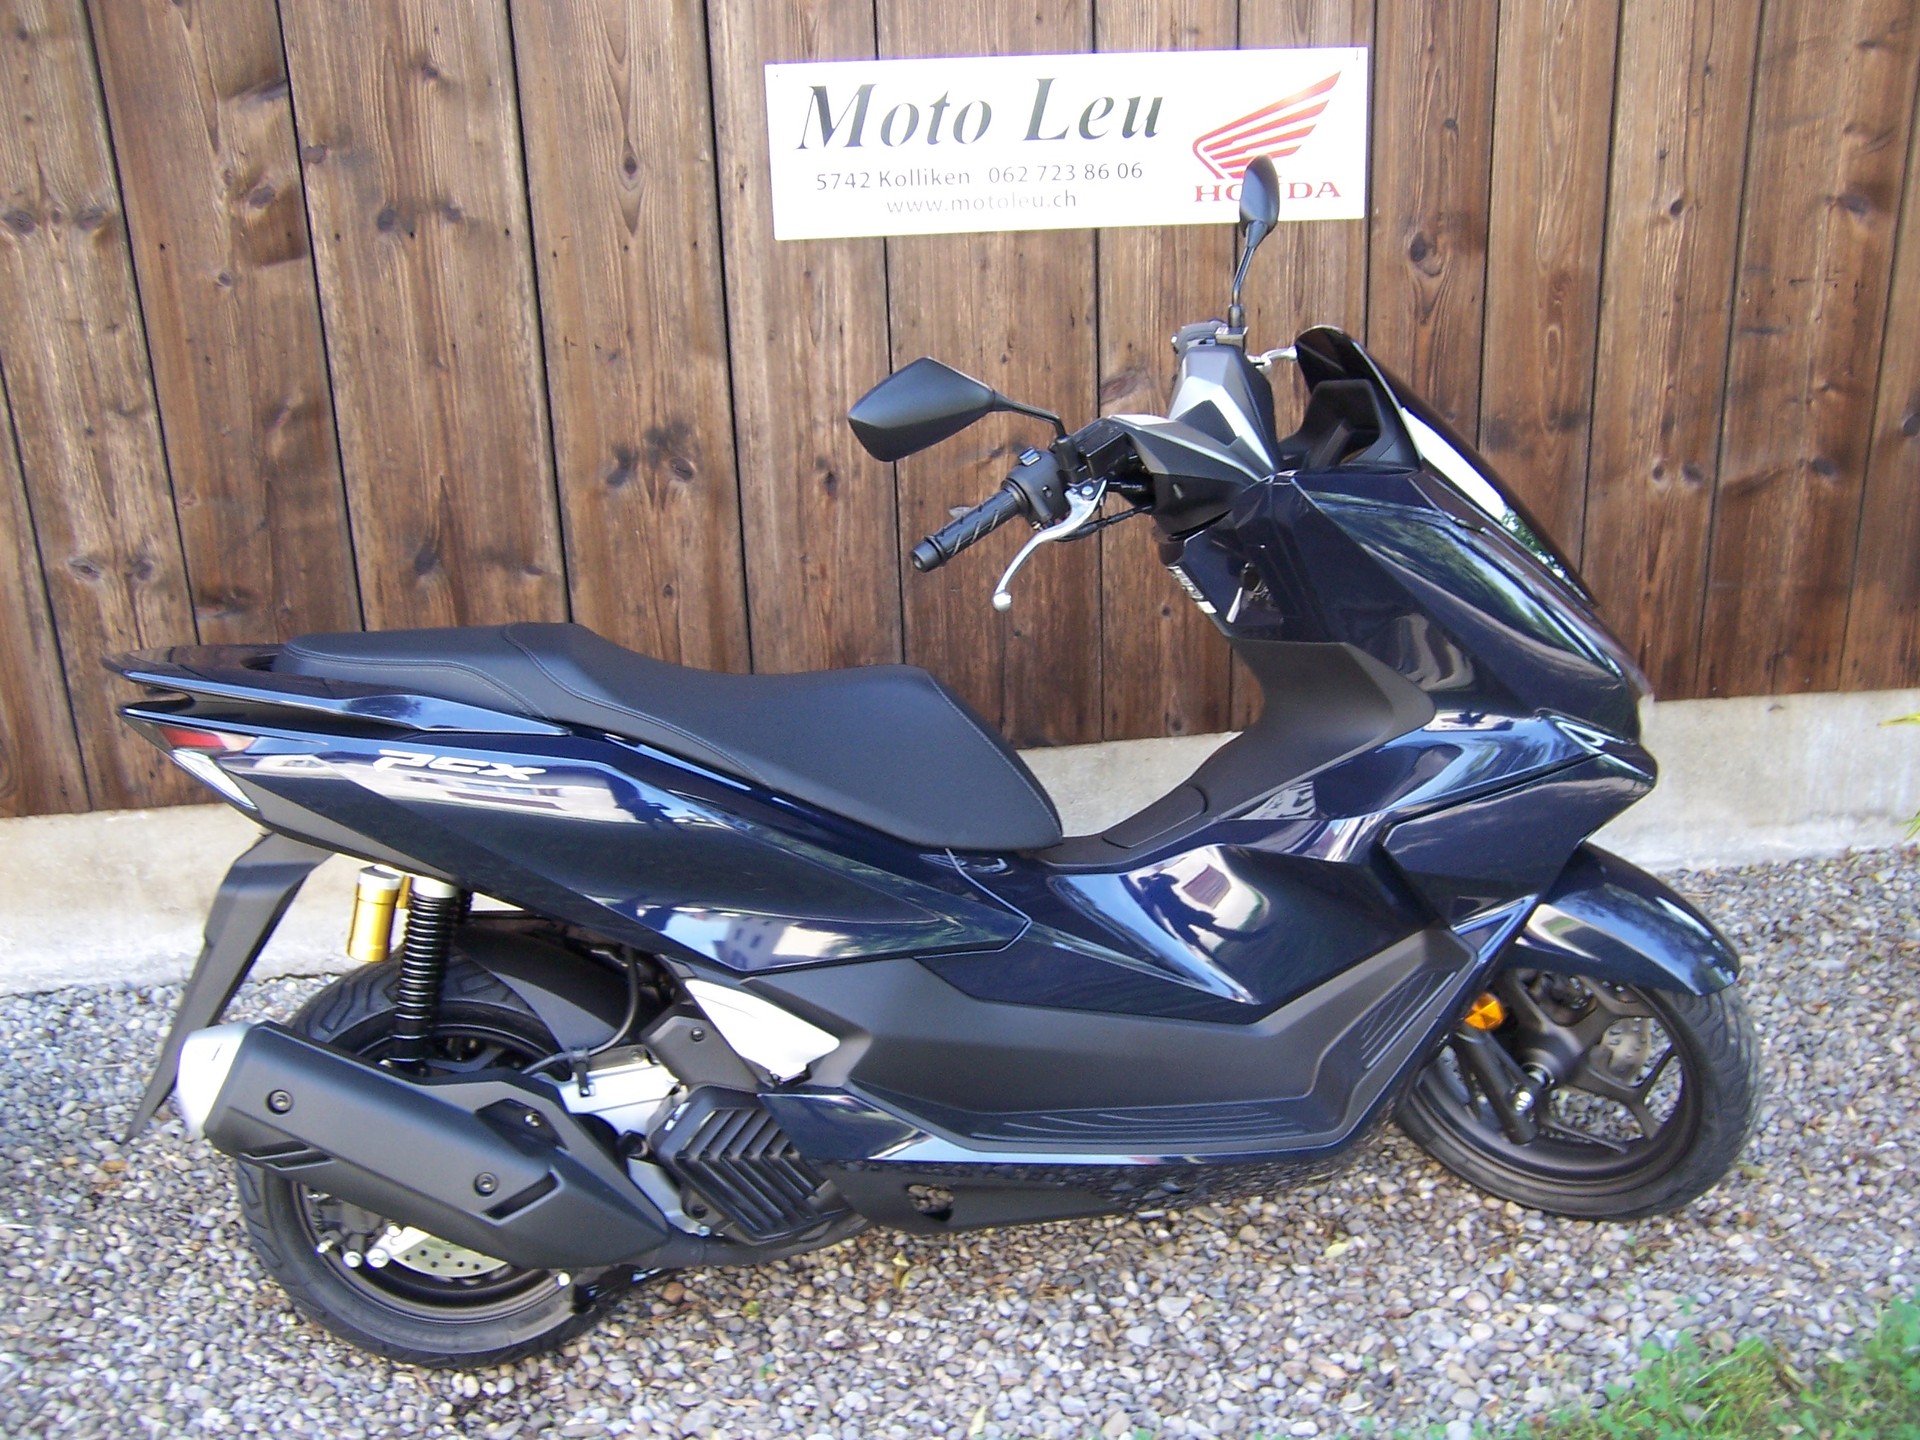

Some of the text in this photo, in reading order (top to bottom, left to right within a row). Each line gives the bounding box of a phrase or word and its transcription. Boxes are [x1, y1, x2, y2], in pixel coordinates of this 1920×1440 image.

[795, 77, 1164, 150] Moto Leu
[816, 162, 1143, 191] 5742 Kolliken 062 723 86 06
[886, 189, 1077, 214] www.motoleu.ch
[1194, 181, 1342, 203] HODA
[372, 748, 547, 781] PCX
